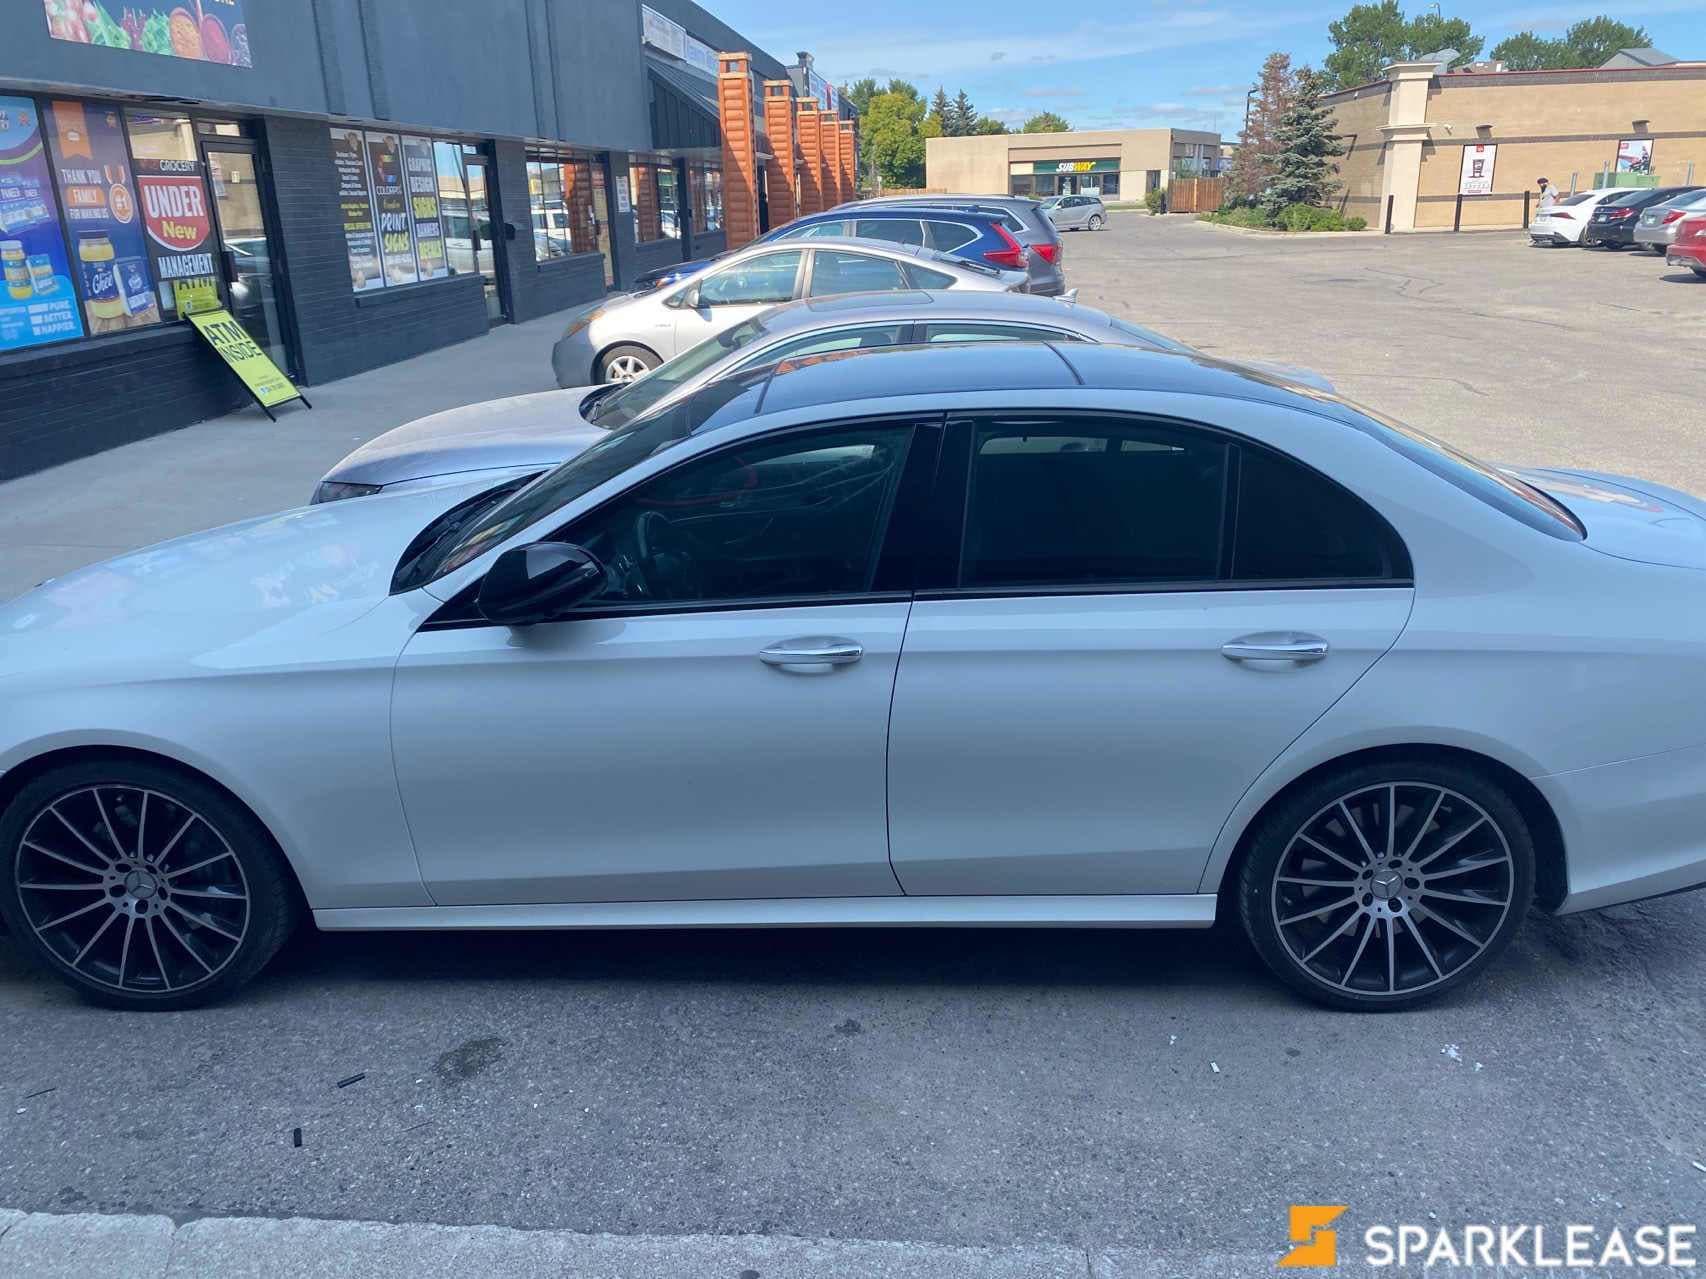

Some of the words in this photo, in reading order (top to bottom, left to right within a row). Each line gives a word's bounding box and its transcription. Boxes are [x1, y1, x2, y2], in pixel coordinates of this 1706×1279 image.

[159, 159, 195, 172] GROCERY
[1055, 161, 1097, 172] SUBWAY
[61, 169, 86, 184] THANK
[143, 185, 205, 219] UNDER
[162, 220, 197, 240] New
[381, 212, 407, 231] PRINT
[384, 231, 410, 253] SIGNS
[157, 253, 214, 279] MANAGEMENT
[203, 320, 249, 346] ATM
[219, 340, 262, 363] INSIDE
